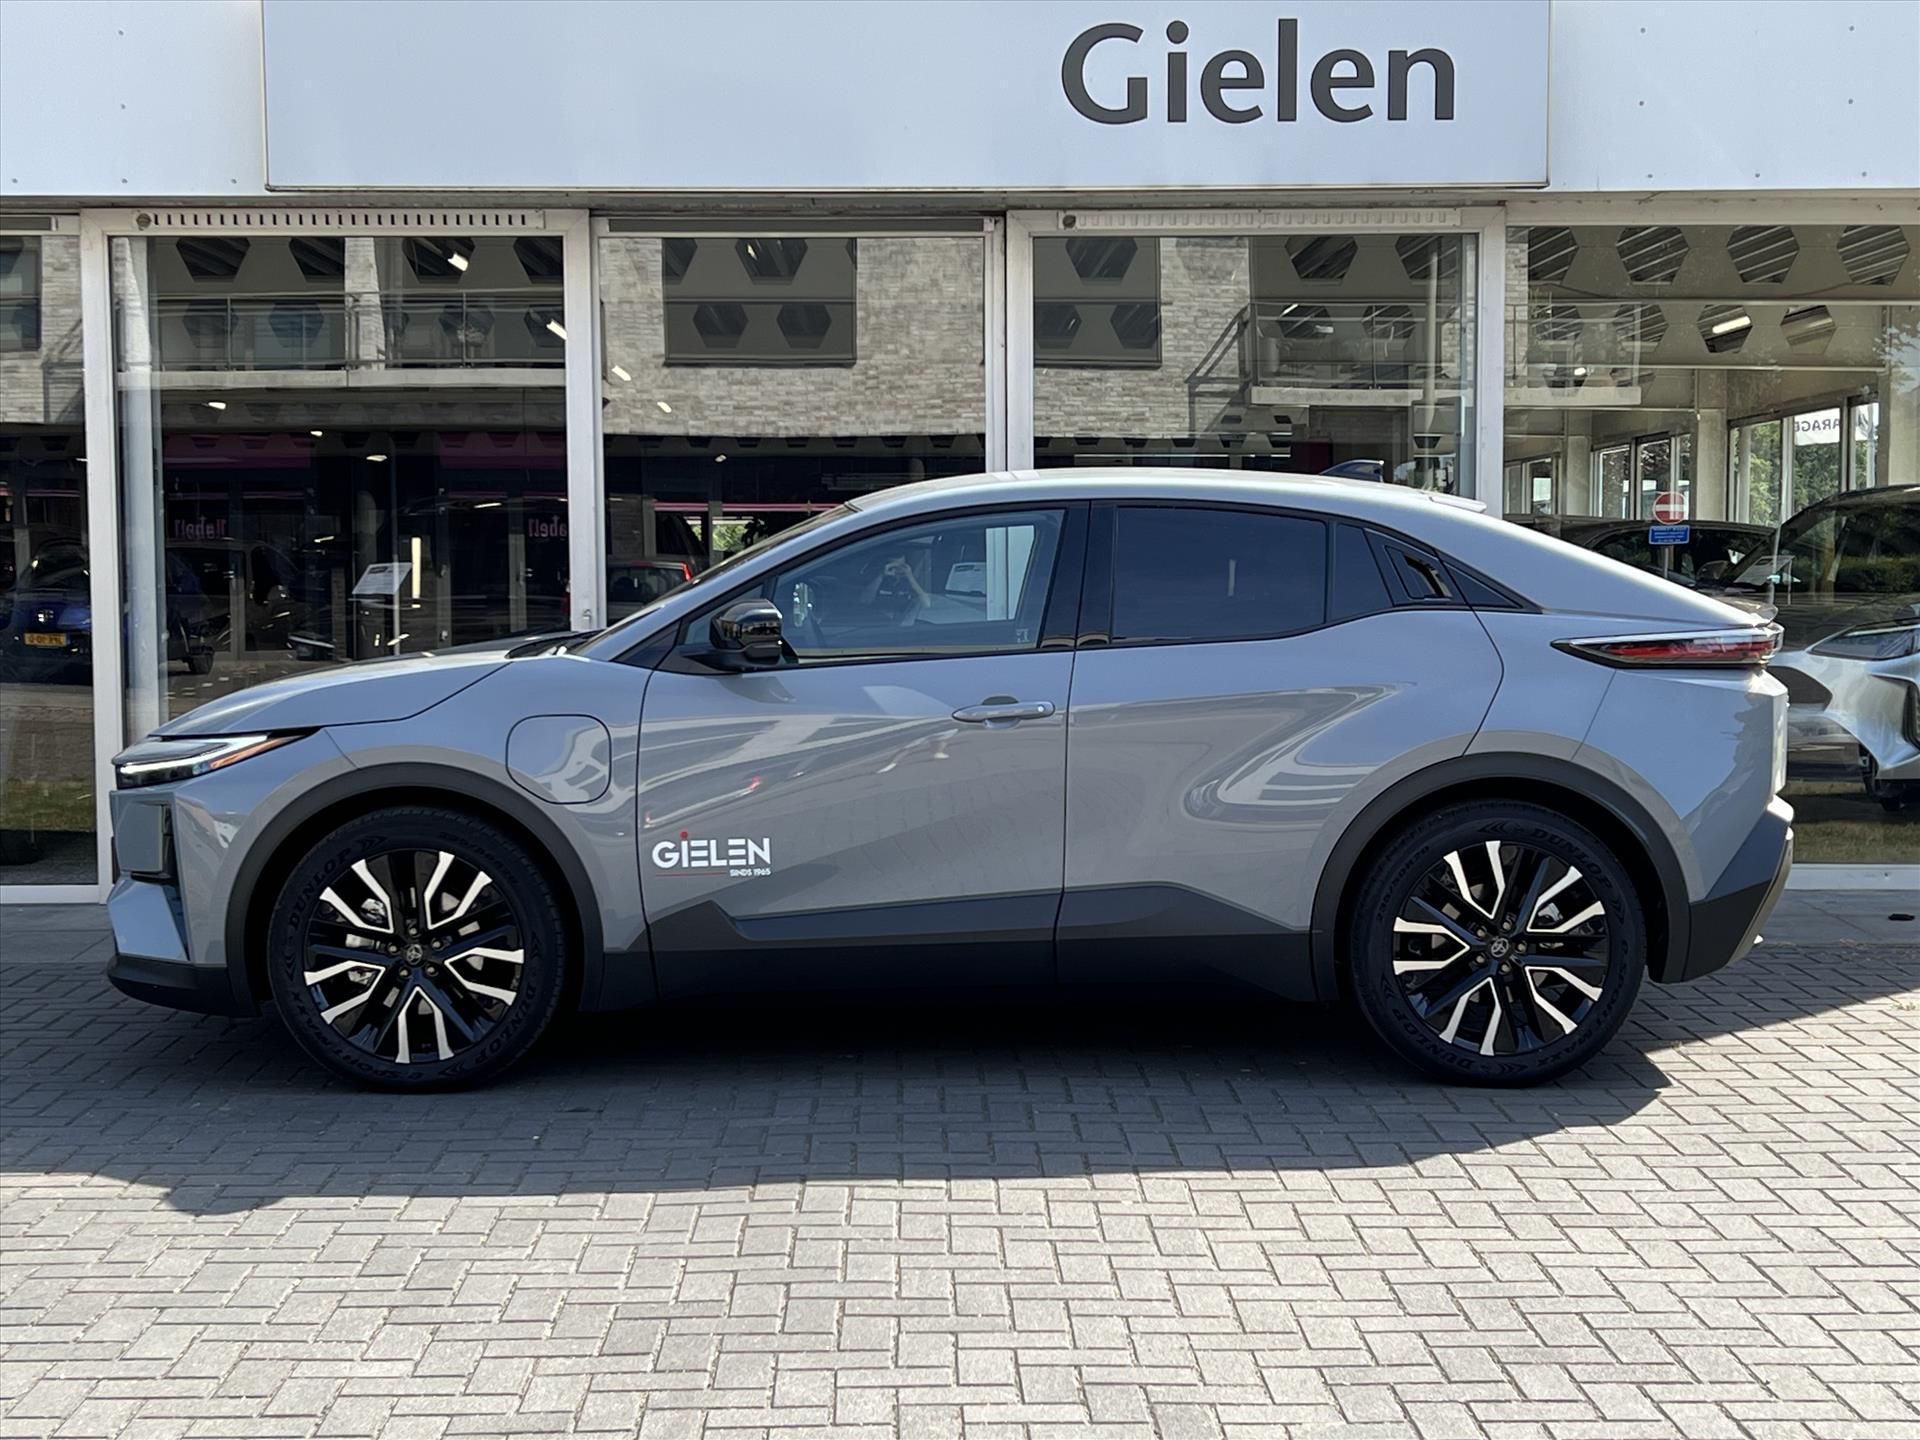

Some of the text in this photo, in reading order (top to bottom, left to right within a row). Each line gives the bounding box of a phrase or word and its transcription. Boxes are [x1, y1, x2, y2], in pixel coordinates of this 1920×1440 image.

[1062, 18, 1455, 125] Gielen
[652, 831, 771, 868] GIELEN
[730, 867, 772, 877] SINDS 1965
[1530, 828, 1613, 889] DUNLOP
[289, 848, 351, 927] DUNLOP
[475, 981, 537, 1063] DUNLOP
[1393, 1008, 1474, 1070] DUNLOP
